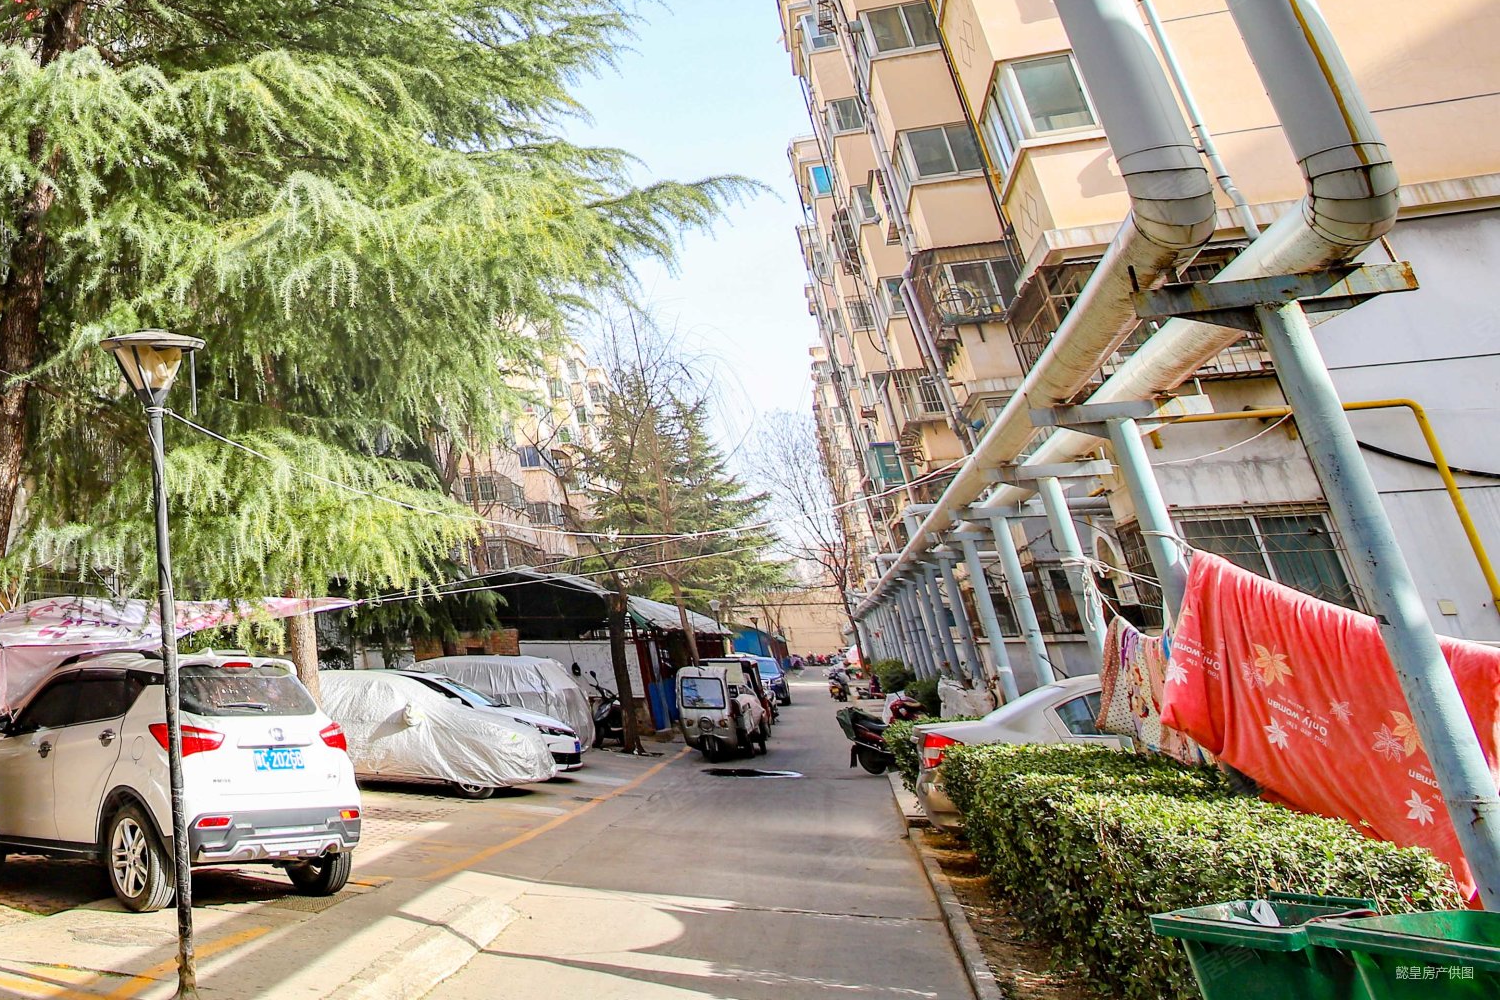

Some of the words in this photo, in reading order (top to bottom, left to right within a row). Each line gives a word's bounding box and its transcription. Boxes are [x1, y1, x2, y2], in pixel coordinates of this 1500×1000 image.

[1267, 697, 1300, 719] woman
[1301, 716, 1328, 737] Only
[1408, 768, 1440, 790] oman
